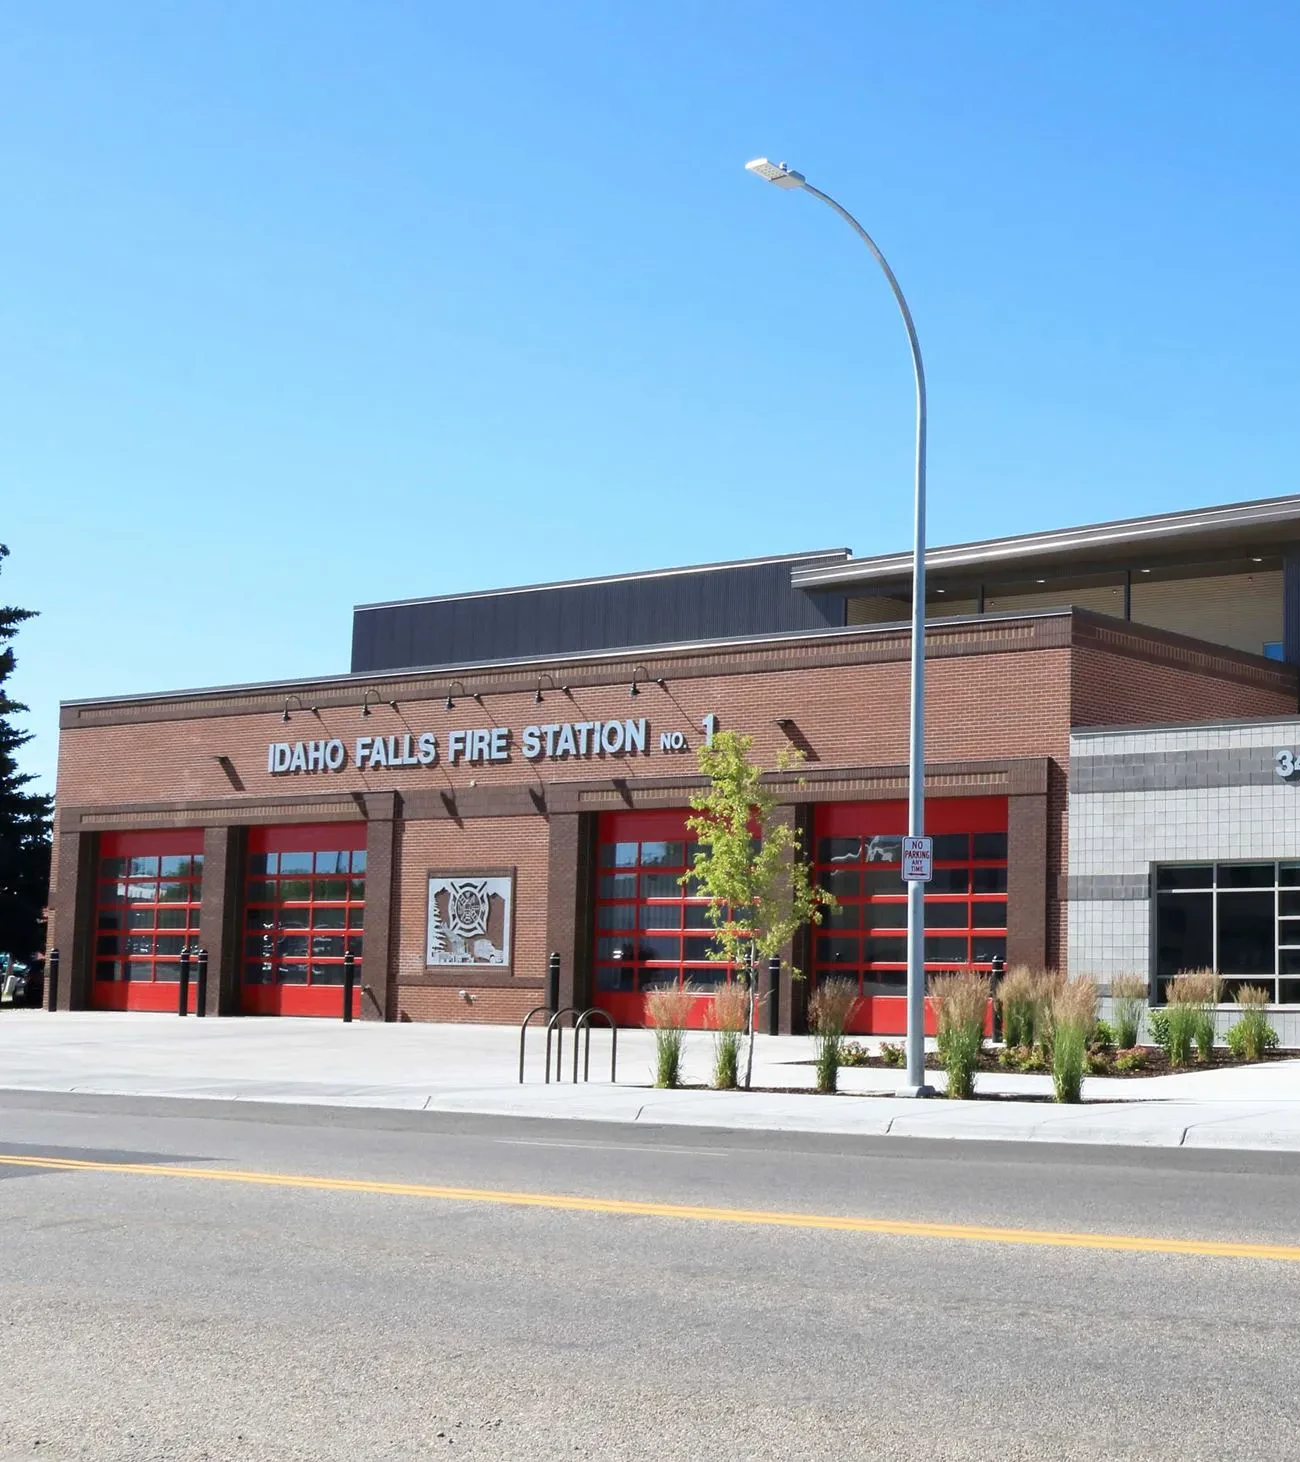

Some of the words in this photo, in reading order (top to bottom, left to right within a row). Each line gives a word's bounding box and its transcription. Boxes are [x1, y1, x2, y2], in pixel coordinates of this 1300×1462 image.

[268, 738, 345, 773] IDAHO
[355, 733, 437, 768] FALLS
[448, 727, 509, 762] FIRE
[521, 717, 647, 758] STATION
[660, 731, 687, 750] NO.
[703, 713, 715, 748] 1
[911, 841, 923, 850] NO
[904, 851, 930, 859] PARKING
